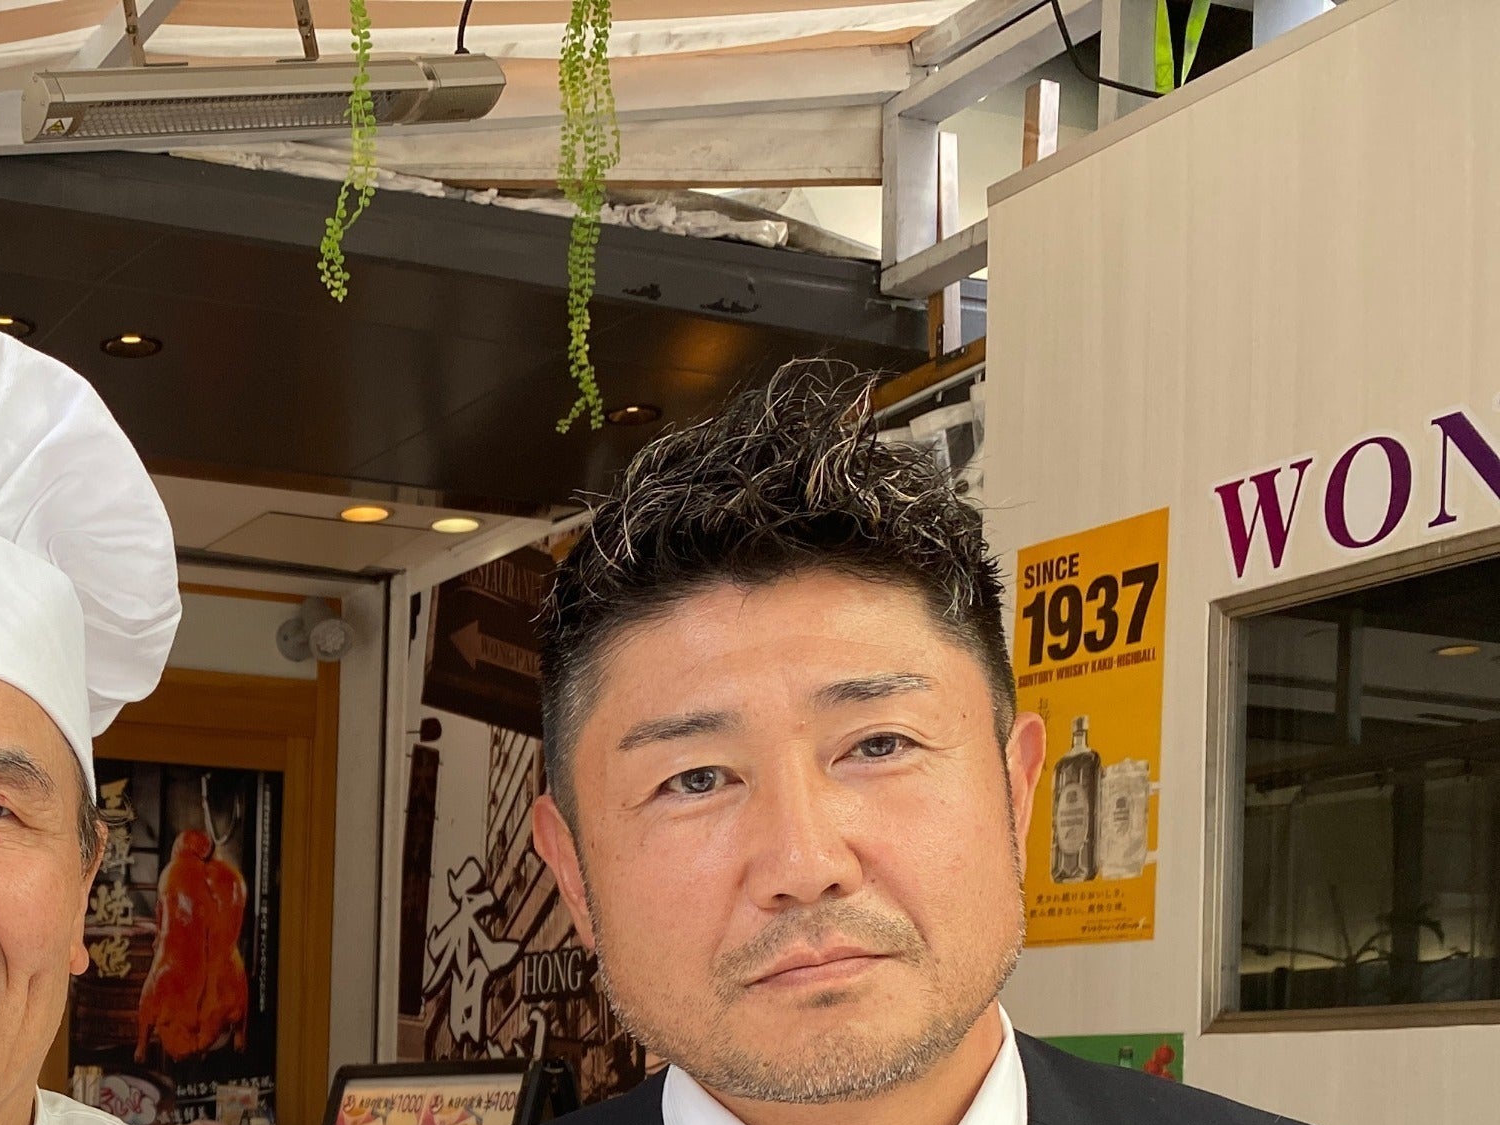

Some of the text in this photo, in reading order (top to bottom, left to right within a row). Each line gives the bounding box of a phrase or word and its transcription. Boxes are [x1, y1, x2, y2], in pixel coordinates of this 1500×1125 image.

[1214, 411, 1500, 578] WON
[1024, 552, 1079, 589] SINCE
[1022, 562, 1159, 667] 1937
[1018, 670, 1054, 689] SUNTORY
[1056, 661, 1090, 681] WHISKY
[523, 949, 583, 996] HONG
